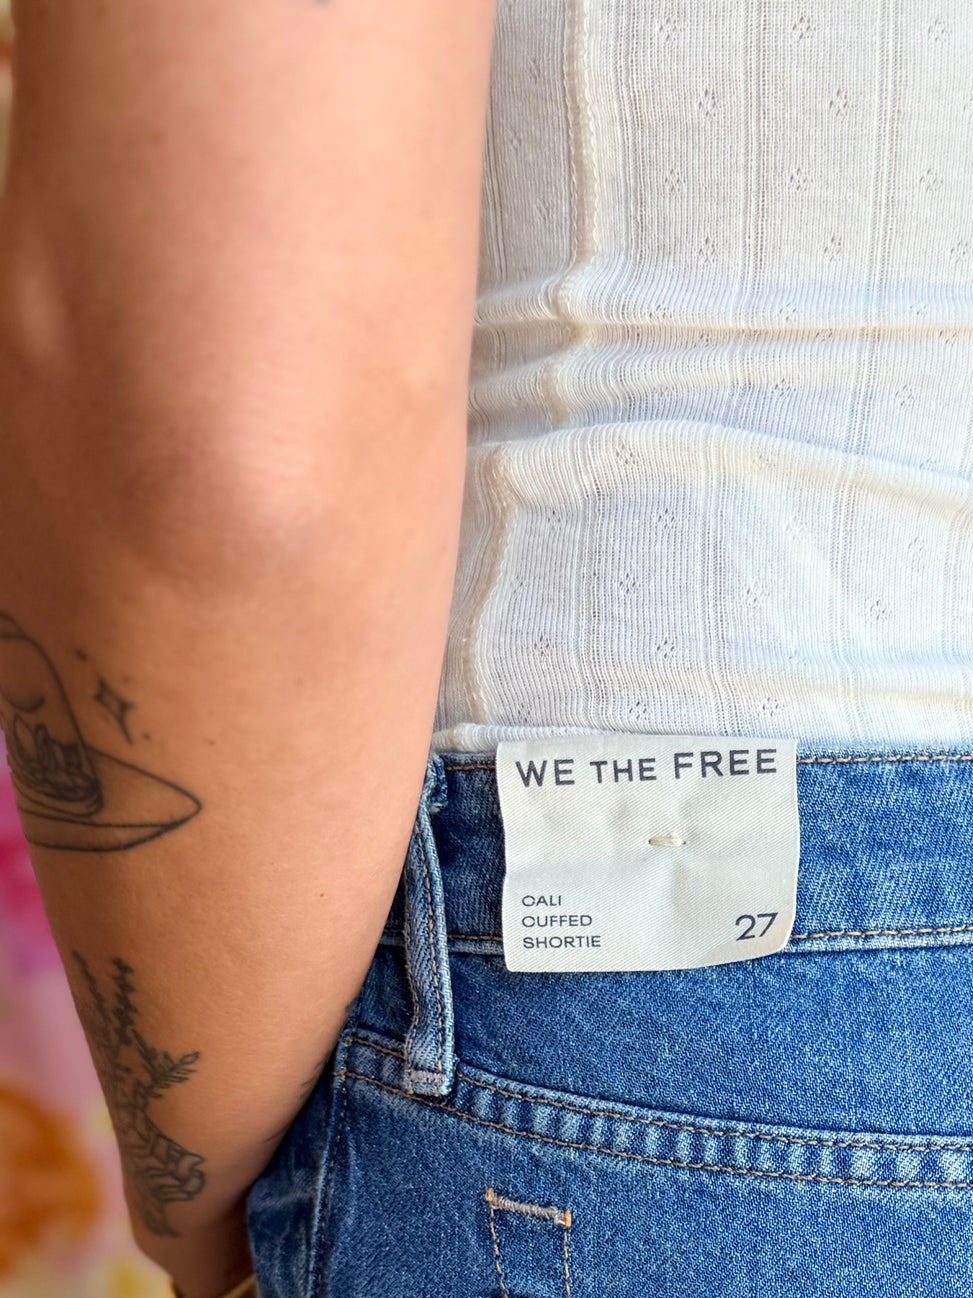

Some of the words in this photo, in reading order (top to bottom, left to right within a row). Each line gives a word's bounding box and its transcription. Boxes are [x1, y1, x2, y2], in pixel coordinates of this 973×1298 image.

[515, 758, 575, 788] WE
[590, 757, 657, 784] THE
[673, 748, 777, 780] FREE
[521, 894, 562, 907] CALI
[521, 914, 593, 928] CUFFED
[735, 912, 779, 942] 27
[522, 935, 601, 949] SHORTIE
